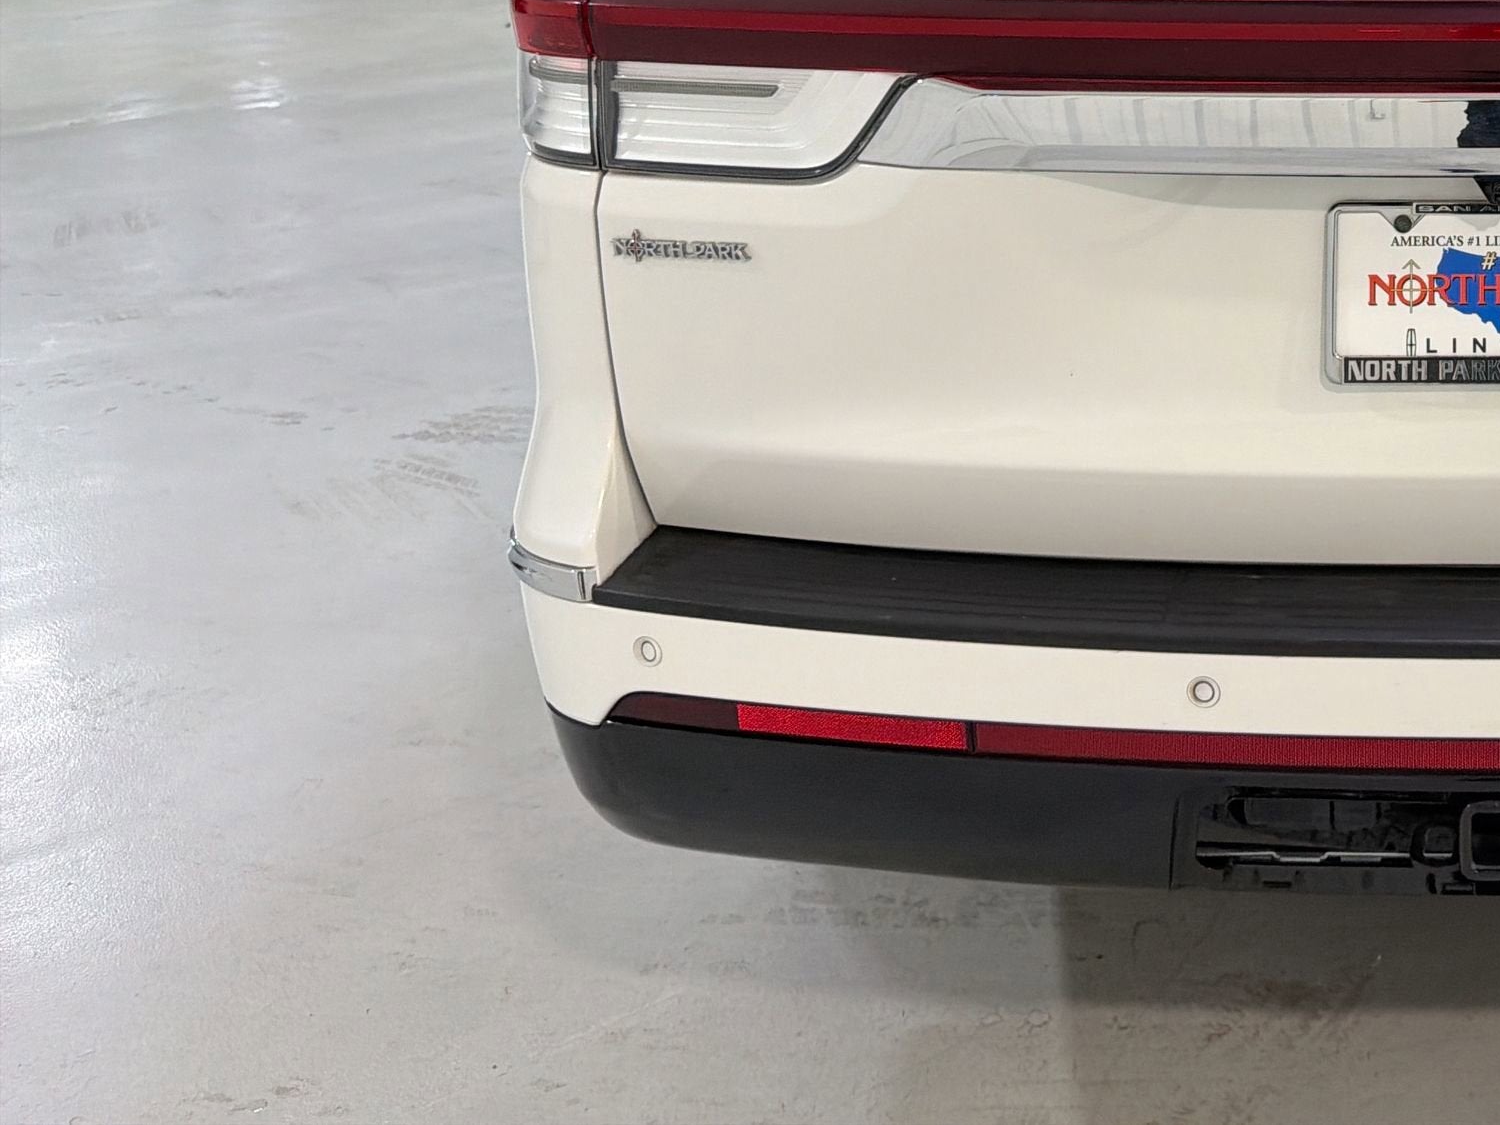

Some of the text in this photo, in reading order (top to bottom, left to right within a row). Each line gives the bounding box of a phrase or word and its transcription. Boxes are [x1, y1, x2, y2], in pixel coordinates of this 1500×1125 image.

[1418, 204, 1472, 213] SAN
[611, 234, 752, 262] NORTH PARK
[1390, 235, 1464, 247] AMERICA'S
[1467, 235, 1481, 247] #1
[1347, 359, 1428, 381] NORTH
